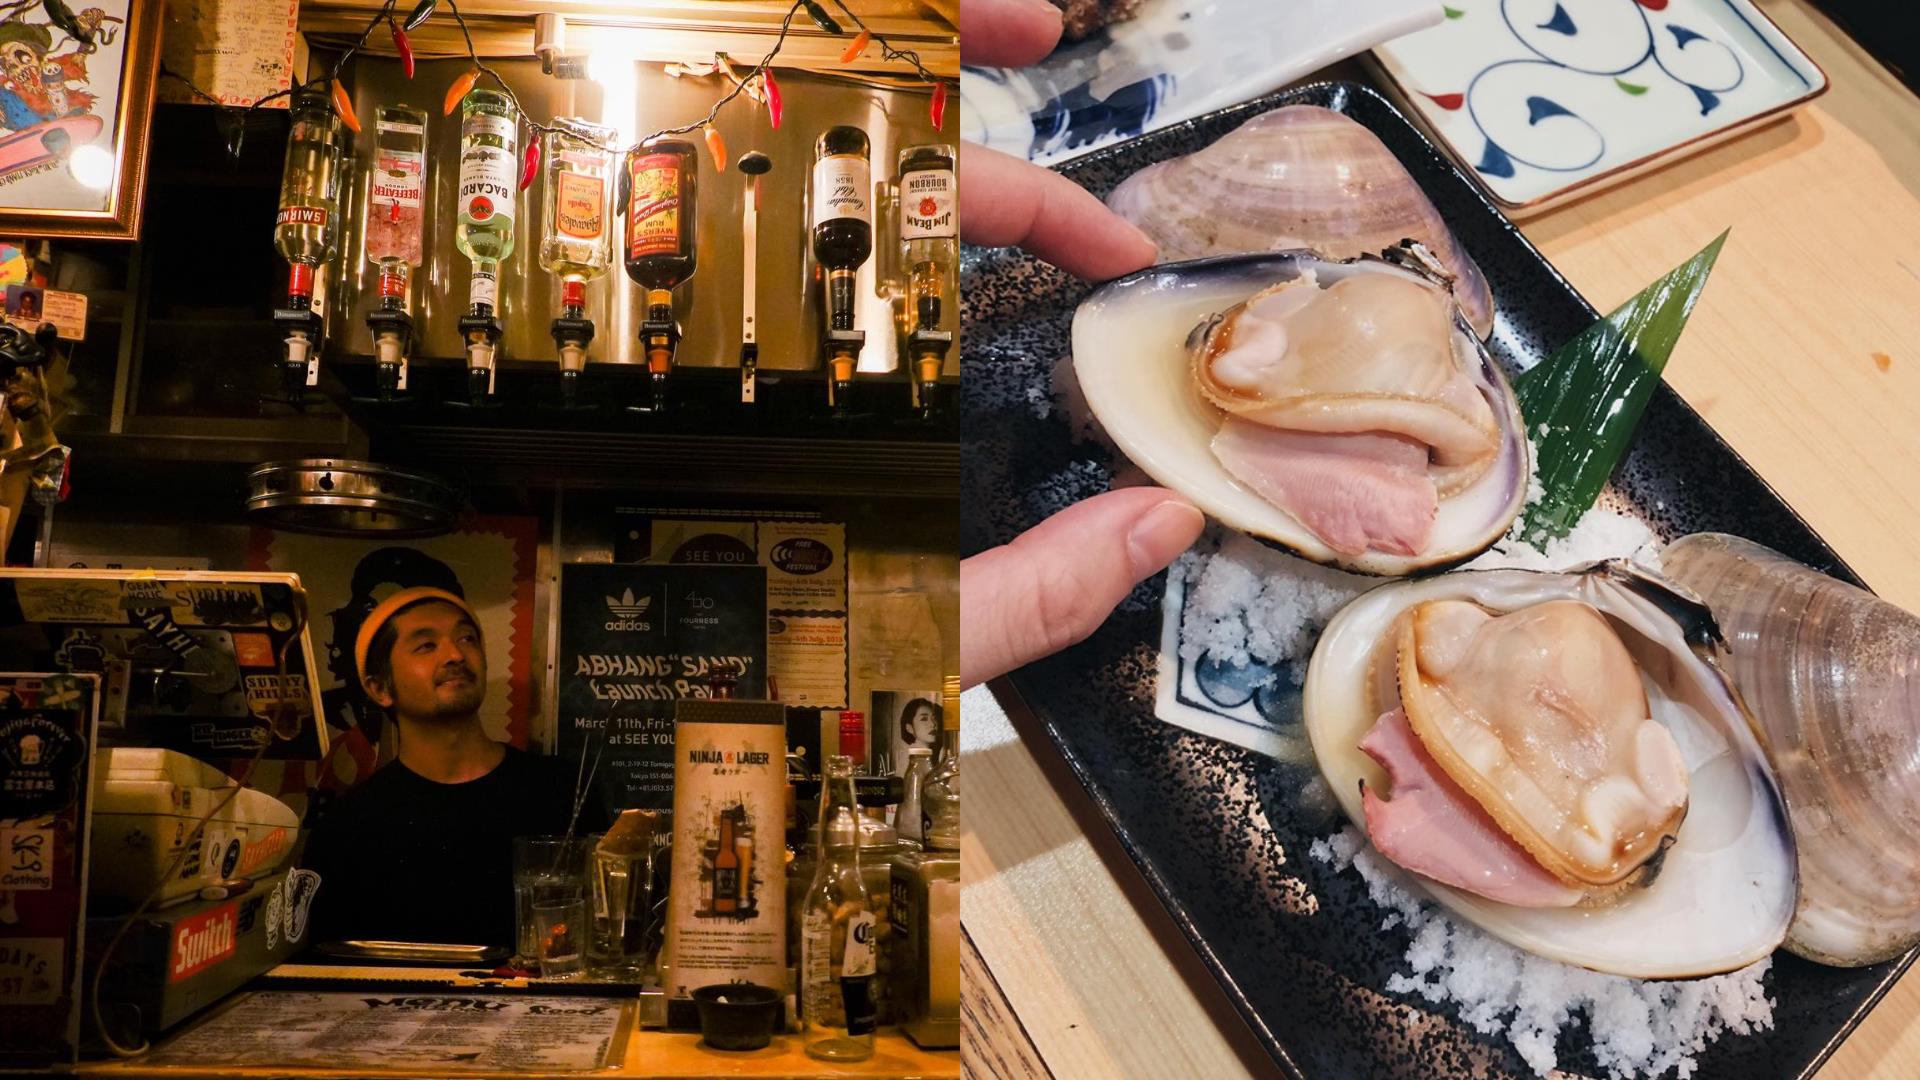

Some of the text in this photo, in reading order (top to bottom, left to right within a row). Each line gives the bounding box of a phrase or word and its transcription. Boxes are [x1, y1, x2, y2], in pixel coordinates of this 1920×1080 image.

[835, 176, 854, 184] 1858
[909, 178, 947, 189] BOURBON
[374, 184, 419, 200] BEEFEATER
[833, 185, 858, 198] Club
[645, 219, 664, 228] RUM
[906, 211, 951, 230] JIM BEAM
[685, 550, 745, 563] SEE YOU
[605, 620, 651, 632] adidas
[589, 678, 711, 700] Launch Par
[575, 717, 609, 729] Marc
[609, 734, 621, 745] at
[624, 733, 649, 745] SEE
[689, 750, 770, 765] NINJA LAGER
[1, 873, 50, 889] Clothing
[175, 911, 232, 975] Switch
